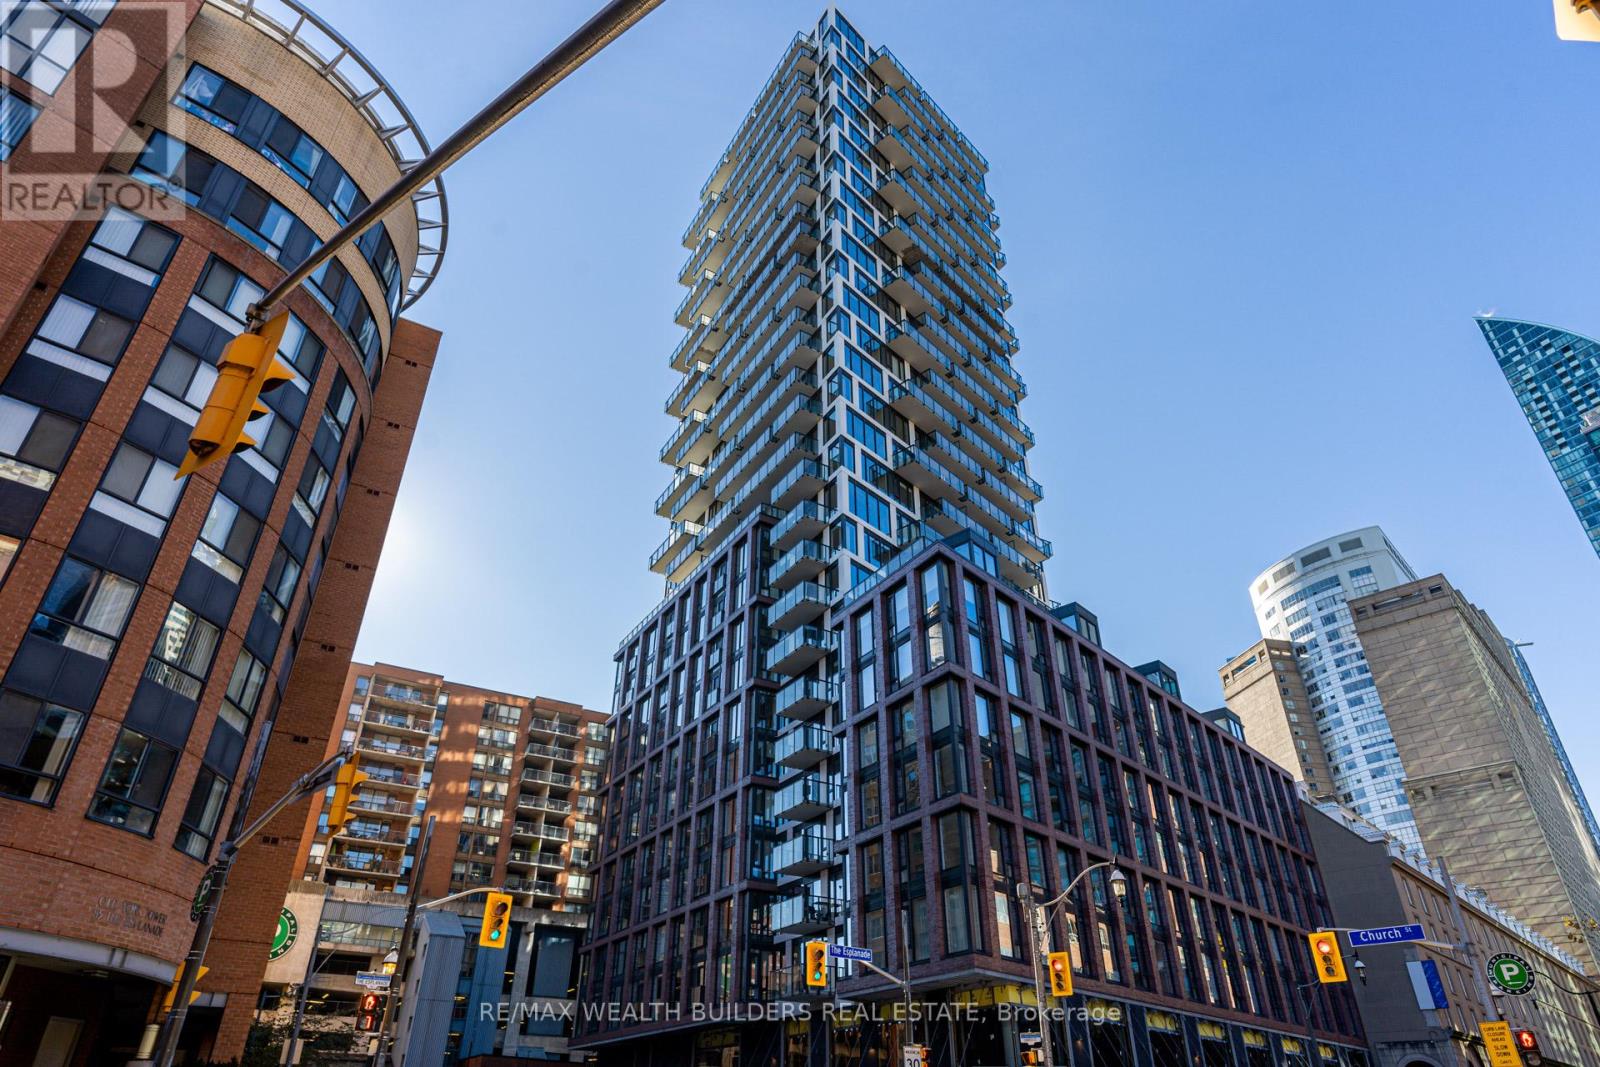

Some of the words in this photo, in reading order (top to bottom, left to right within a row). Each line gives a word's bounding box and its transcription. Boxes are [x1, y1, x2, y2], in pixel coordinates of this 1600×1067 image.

[1360, 927, 1402, 942] Church
[832, 945, 842, 955] The
[843, 947, 871, 959] Esplanade
[1500, 963, 1519, 981] P
[906, 1058, 920, 1067] 30
